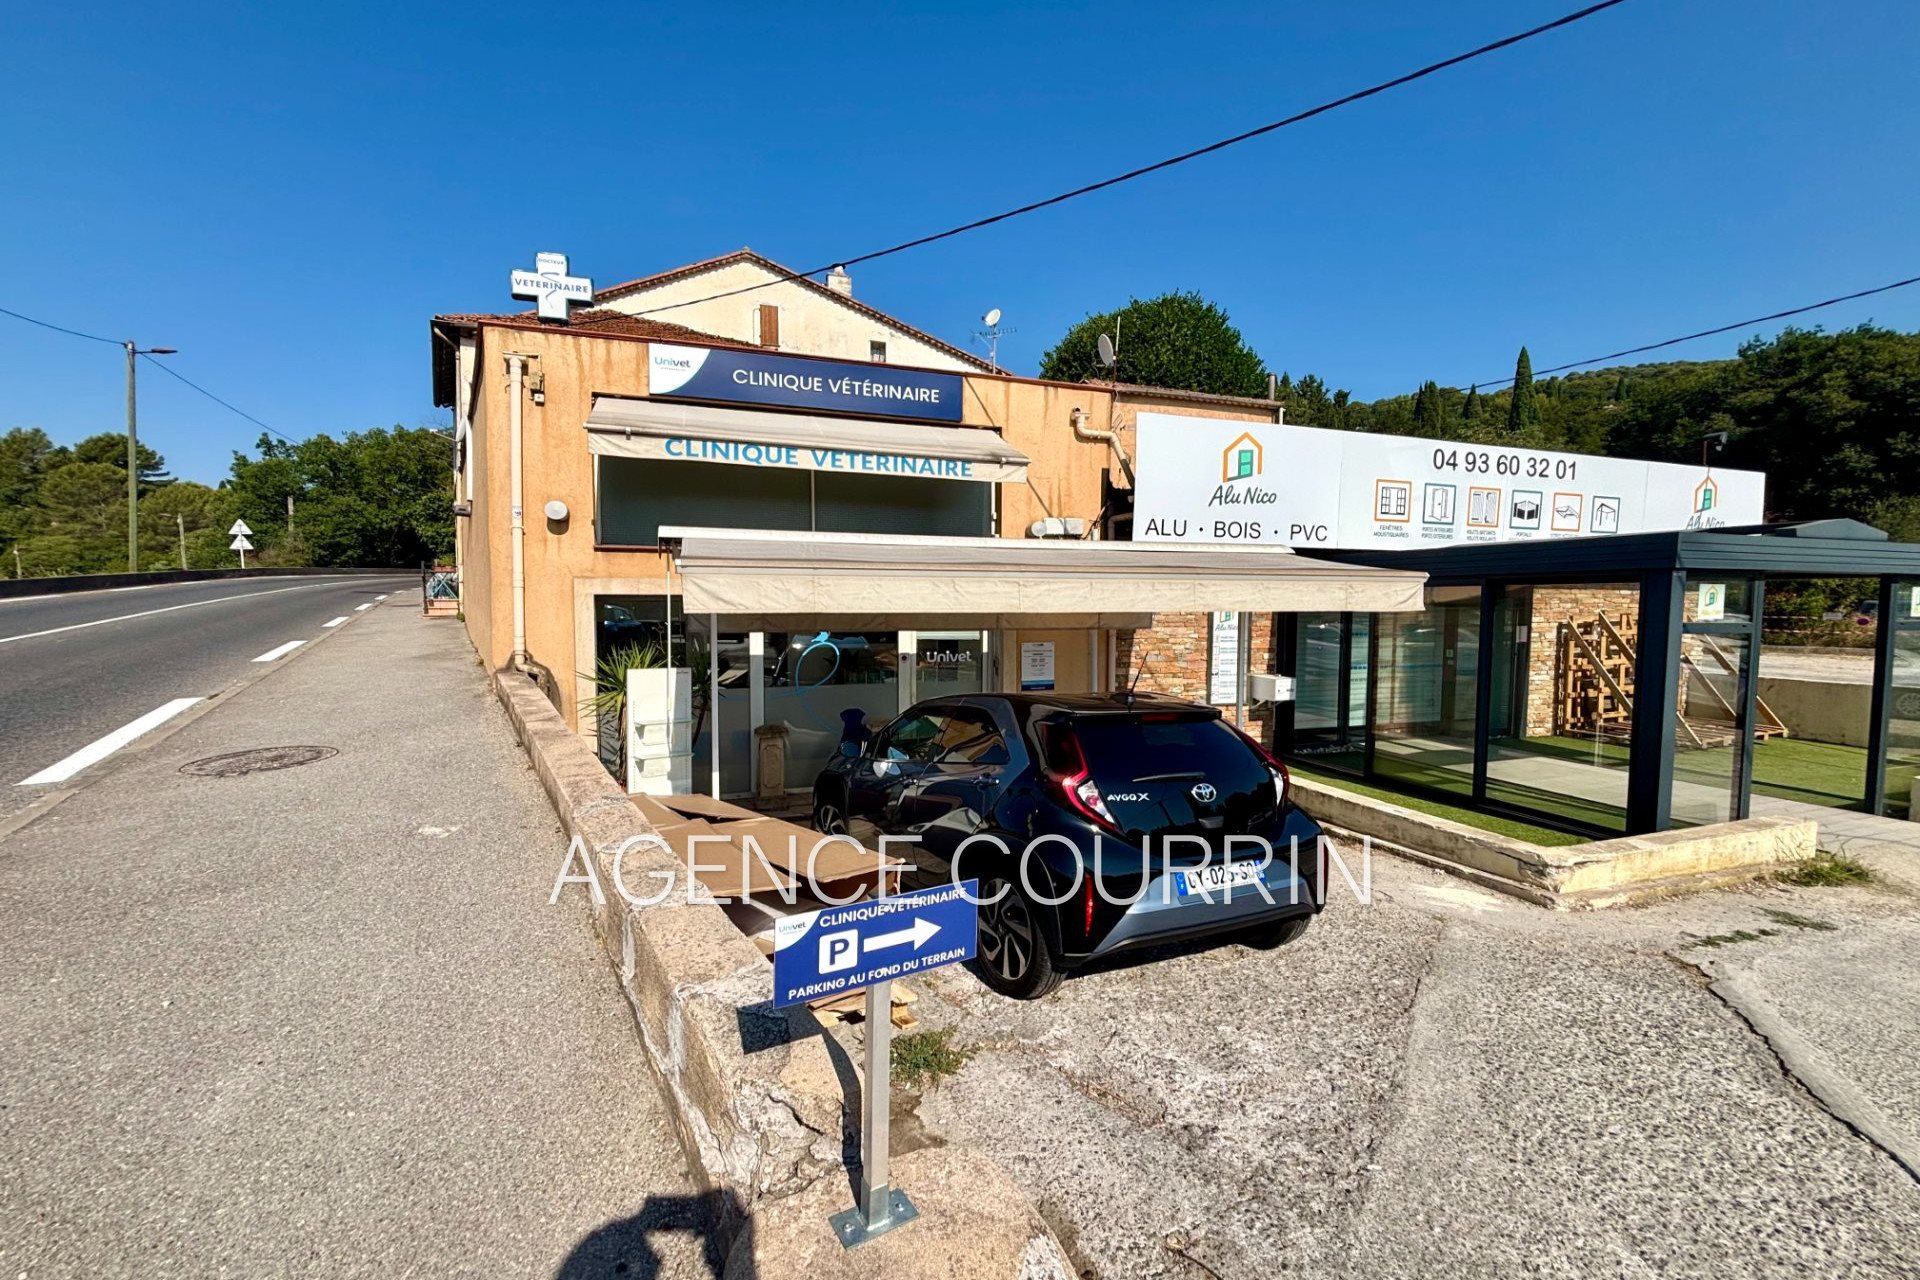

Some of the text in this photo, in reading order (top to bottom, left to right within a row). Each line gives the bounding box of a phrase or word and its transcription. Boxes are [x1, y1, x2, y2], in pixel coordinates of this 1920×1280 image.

[514, 278, 589, 293] VETERINAIRE
[654, 356, 691, 368] Univet
[732, 369, 940, 403] CLINIQUE VÉTÉRINAIRE
[664, 437, 974, 478] CLINIQUE VETERINAIRE
[1432, 448, 1578, 481] 04 93 60 32 01
[1208, 484, 1277, 507] Alu Nico
[1144, 518, 1328, 542] ALU BOIS PVC
[926, 650, 972, 662] Univet
[1107, 792, 1150, 801] AYGO X
[819, 887, 967, 928] CLINIQUE VÉTÉRINAIRE
[829, 938, 850, 966] P
[788, 947, 966, 1000] PARKING AU FOND DU TERRAIN
